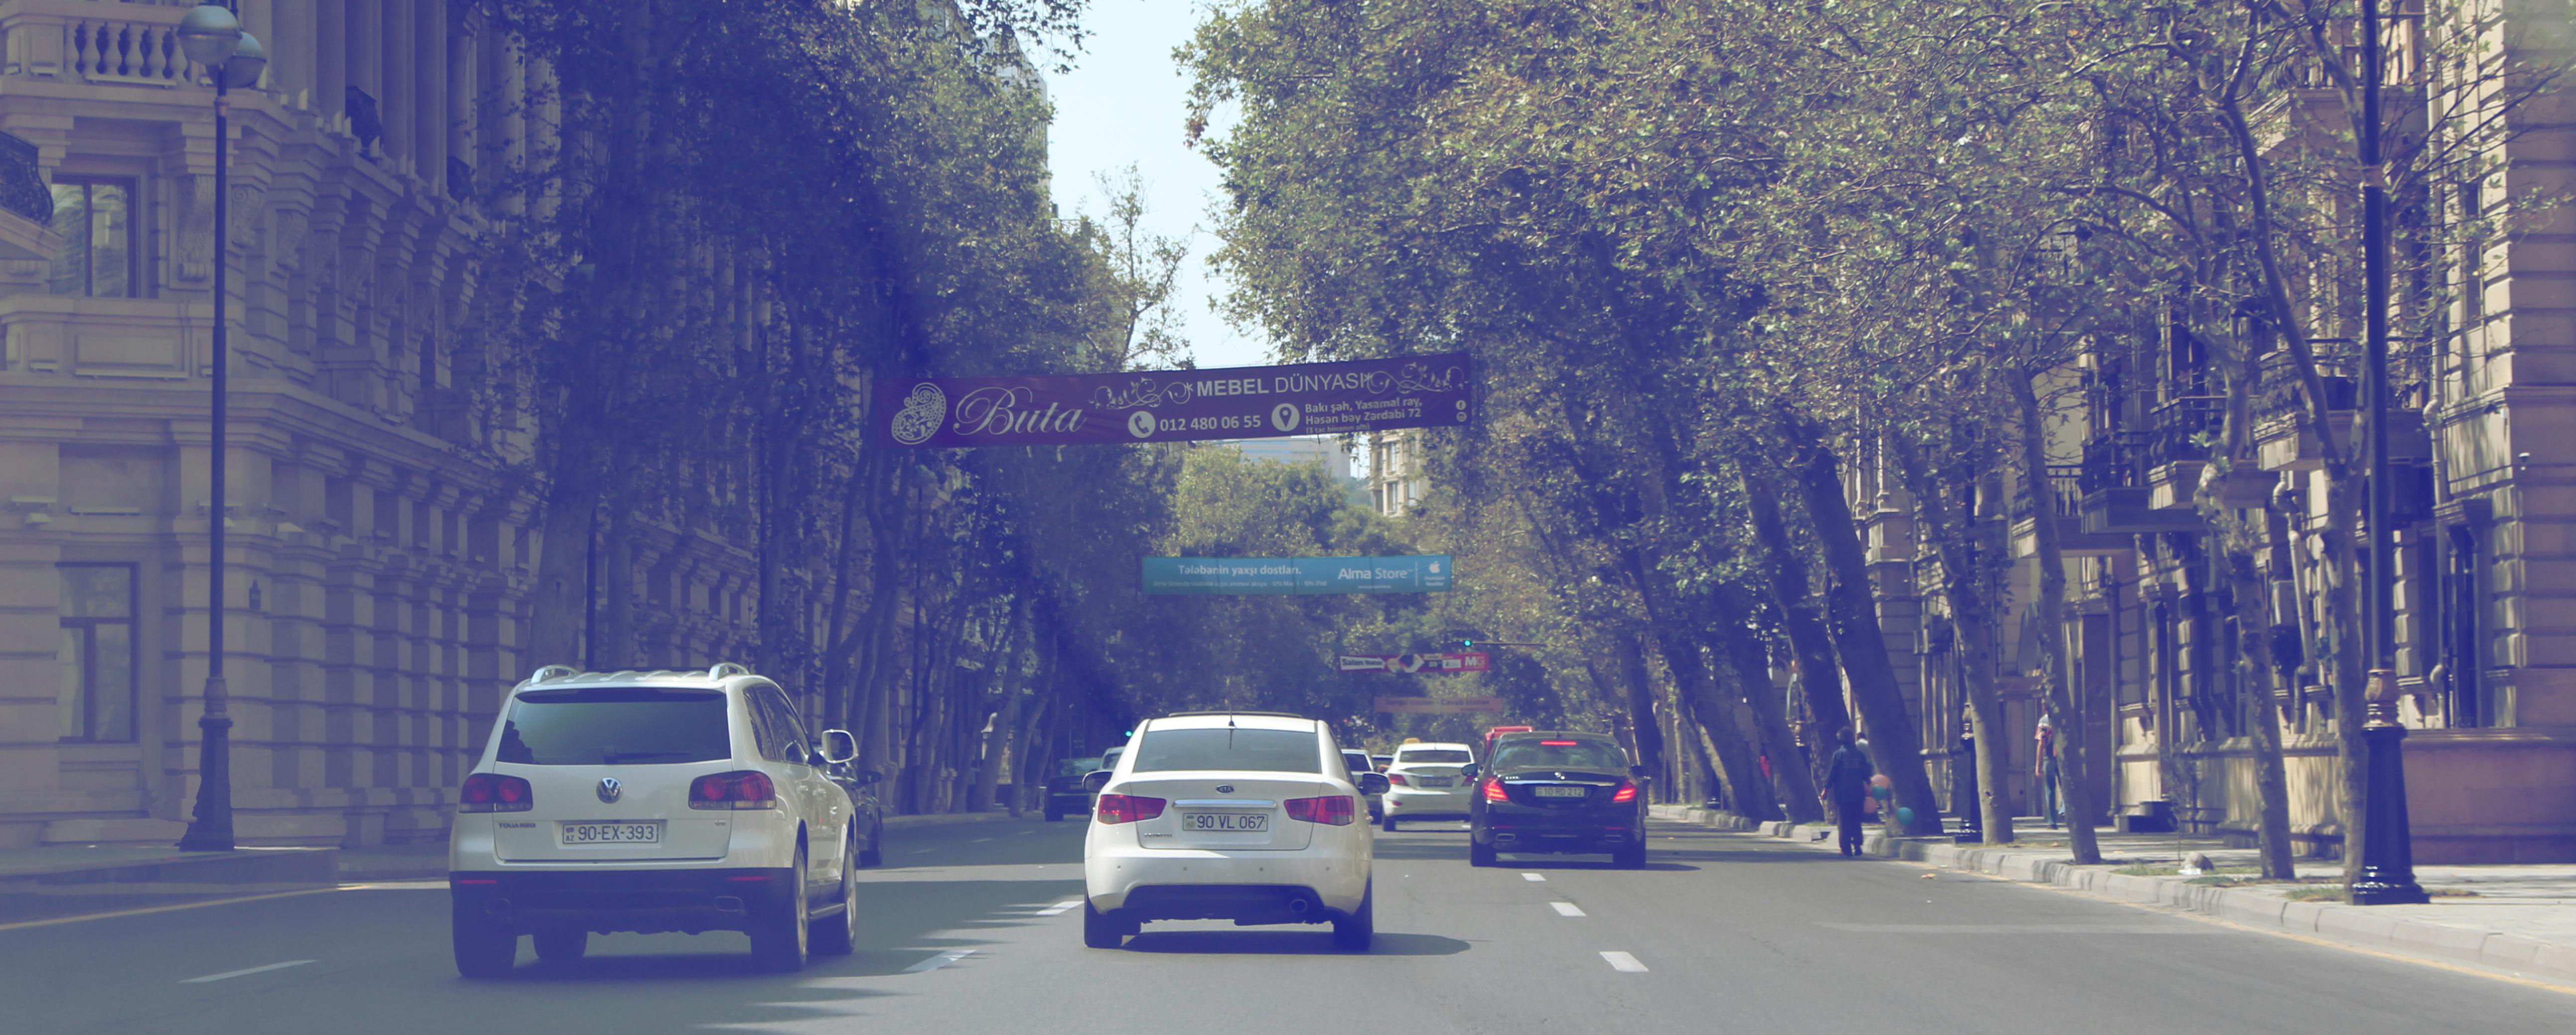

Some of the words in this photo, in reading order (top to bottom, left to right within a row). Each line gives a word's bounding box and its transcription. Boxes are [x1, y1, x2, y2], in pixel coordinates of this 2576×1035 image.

[1197, 379, 1269, 397] MEBEL
[1275, 373, 1366, 393] DÜNYASI
[952, 386, 1087, 435] Buta
[1305, 402, 1328, 413] Bakı
[1331, 401, 1353, 413] şəh,
[1355, 397, 1400, 410] Yasamal
[1402, 398, 1423, 408] ray,
[1160, 418, 1186, 432] 012
[1191, 417, 1217, 430] 480
[1221, 416, 1240, 429] 06
[1243, 415, 1261, 428] 55
[1306, 415, 1339, 425] Həsən
[1342, 413, 1361, 423] bəy
[1364, 409, 1405, 421] Zərdabi
[1408, 408, 1422, 417] 72
[1231, 567, 1257, 577] yaxşı
[1338, 568, 1371, 579] Alma
[1375, 568, 1407, 579] Store
[1544, 787, 1554, 796] 10
[1568, 787, 1583, 796] 212
[1197, 815, 1214, 828] 90
[1219, 815, 1235, 829] VL
[1239, 815, 1265, 829] 067
[578, 825, 654, 841] 90-EX-393
